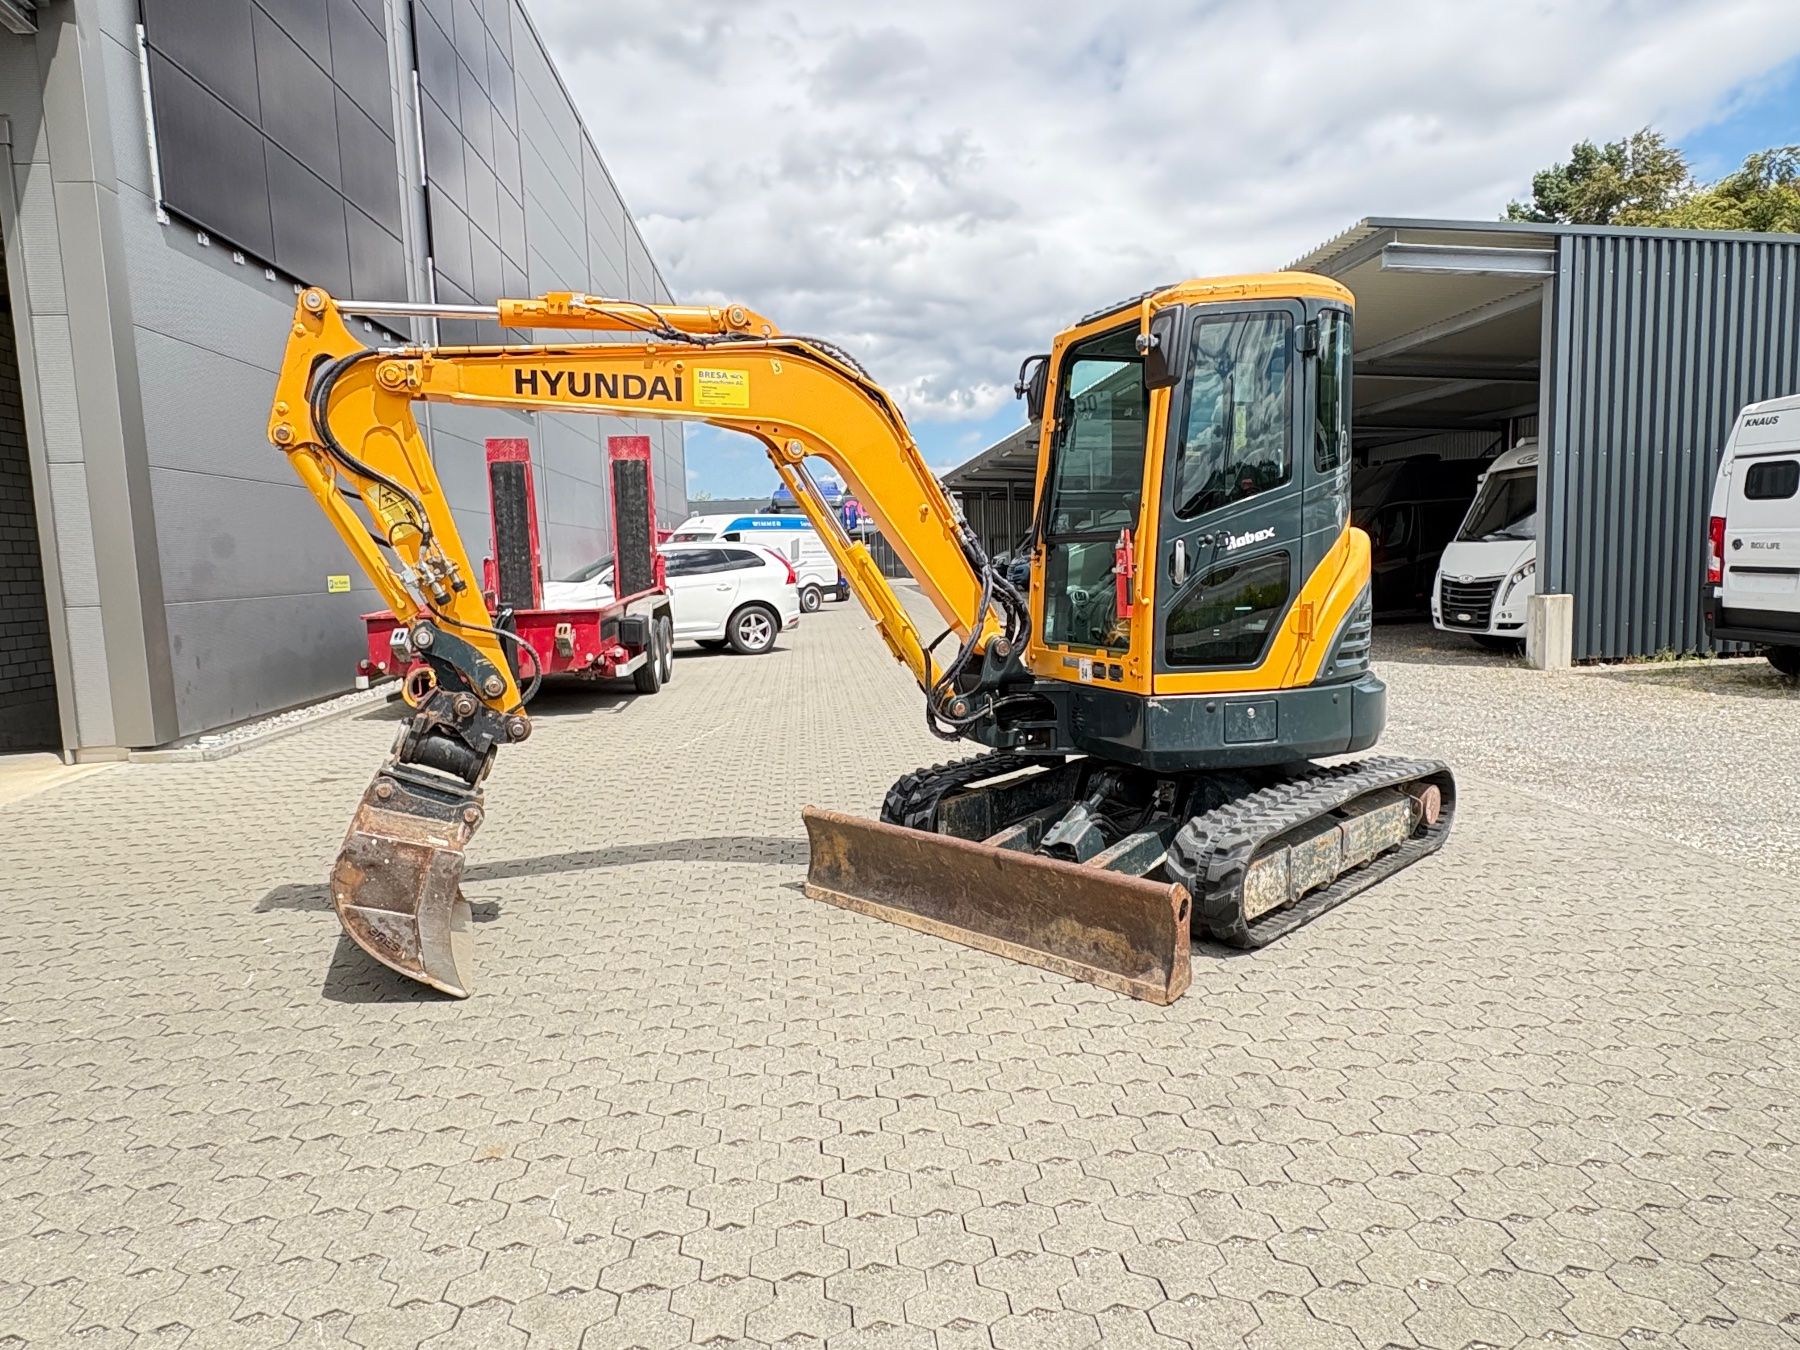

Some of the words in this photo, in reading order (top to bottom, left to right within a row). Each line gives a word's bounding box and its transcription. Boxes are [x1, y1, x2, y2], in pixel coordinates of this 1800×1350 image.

[698, 370, 728, 379] BRESA
[514, 368, 683, 402] HYUNDAI
[1744, 415, 1780, 428] KNAUS
